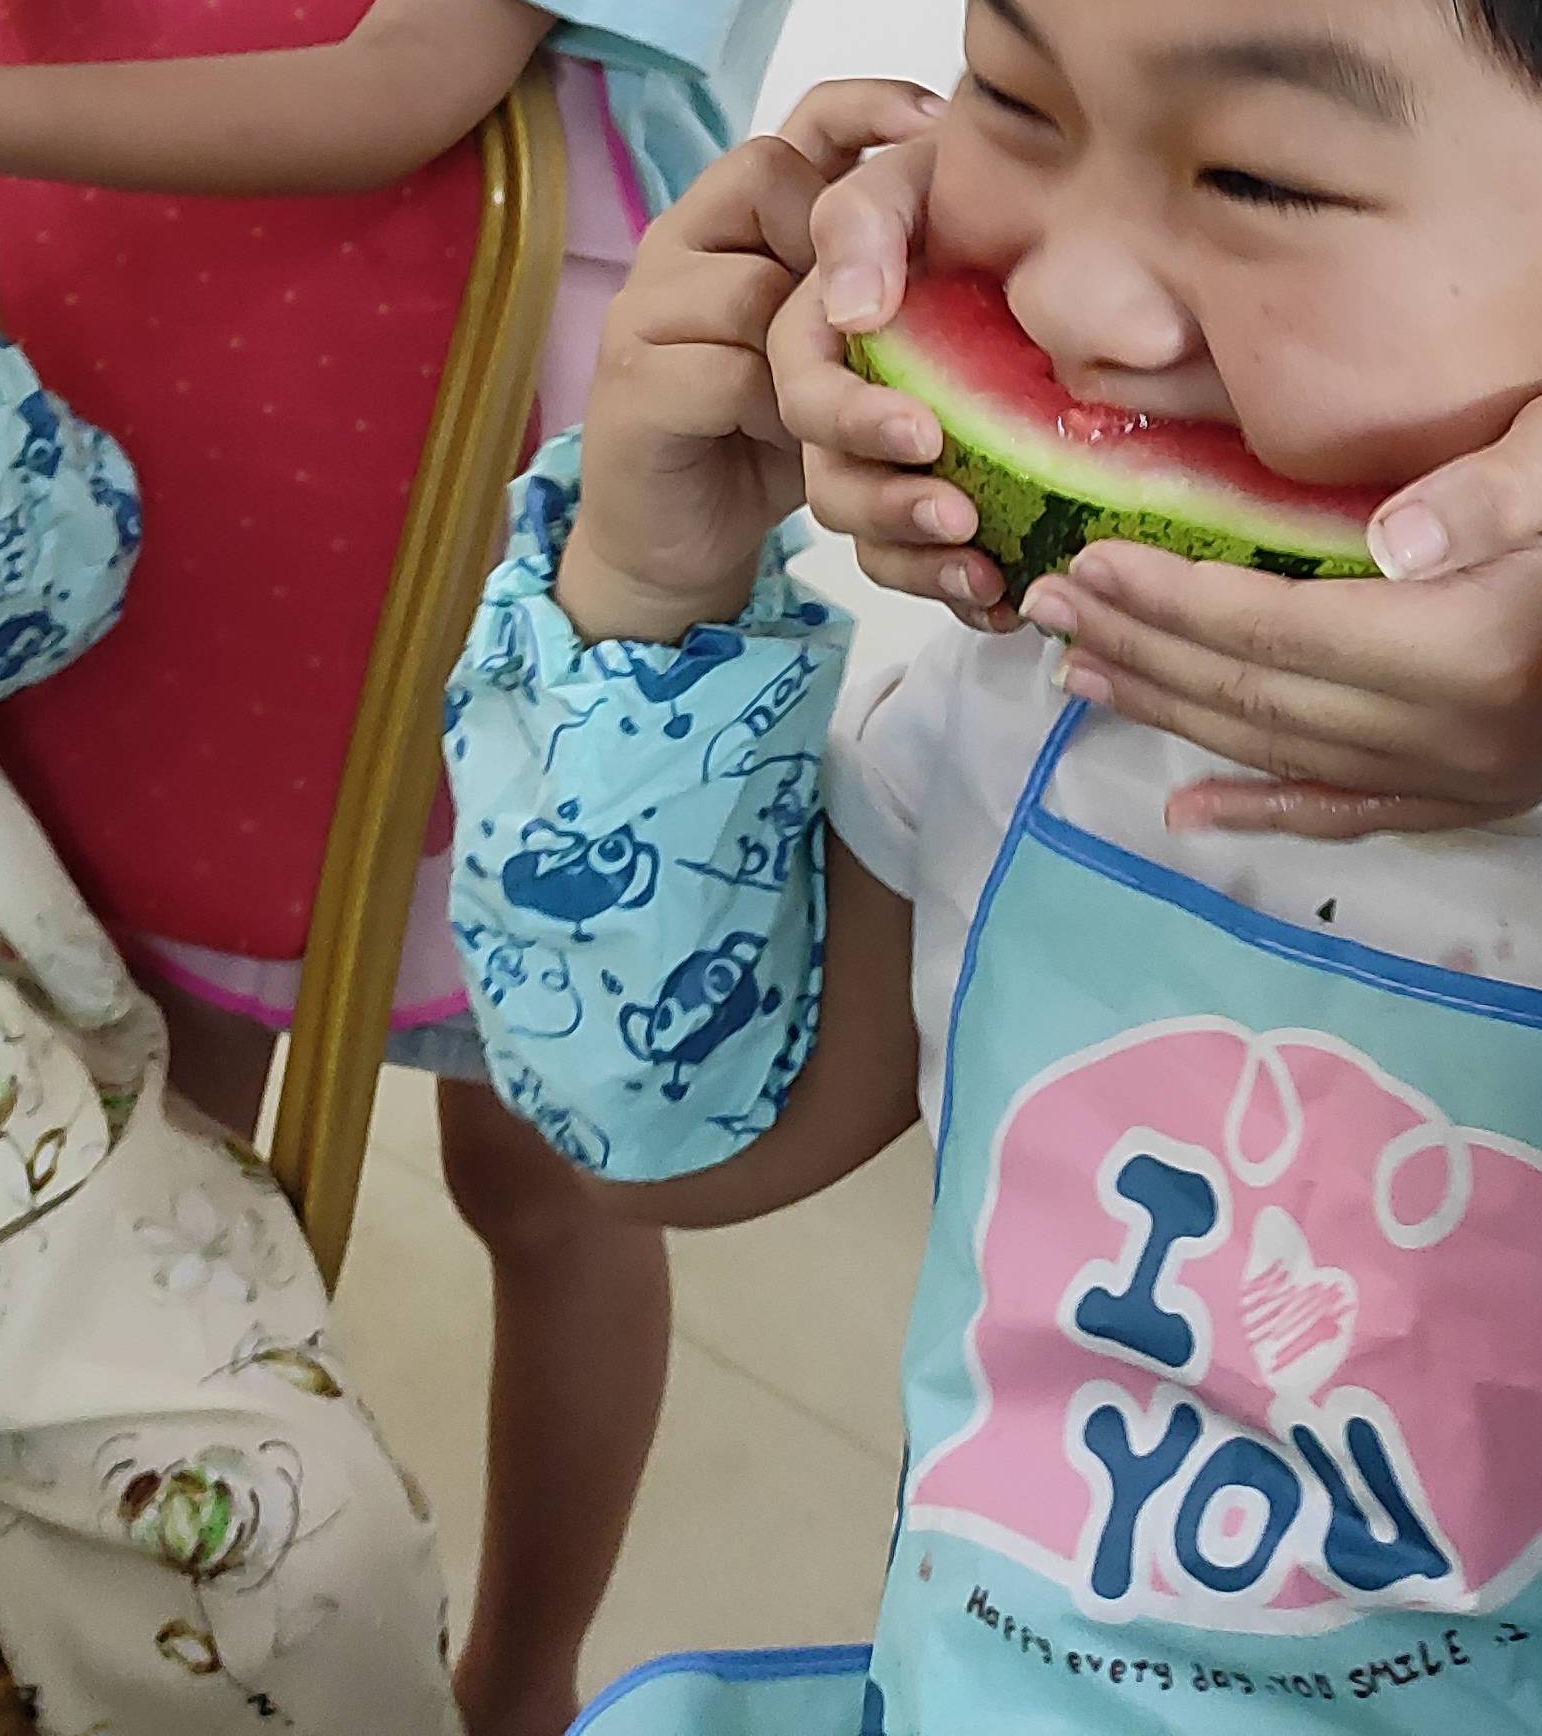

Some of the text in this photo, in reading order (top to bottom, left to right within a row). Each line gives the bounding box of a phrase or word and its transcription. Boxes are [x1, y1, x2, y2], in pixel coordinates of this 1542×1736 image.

[1074, 1153, 1219, 1369] I
[1083, 1402, 1452, 1600] YOU
[965, 1584, 1053, 1664] Happy
[1066, 1651, 1174, 1691] every
[1348, 1629, 1470, 1699] SMILE
